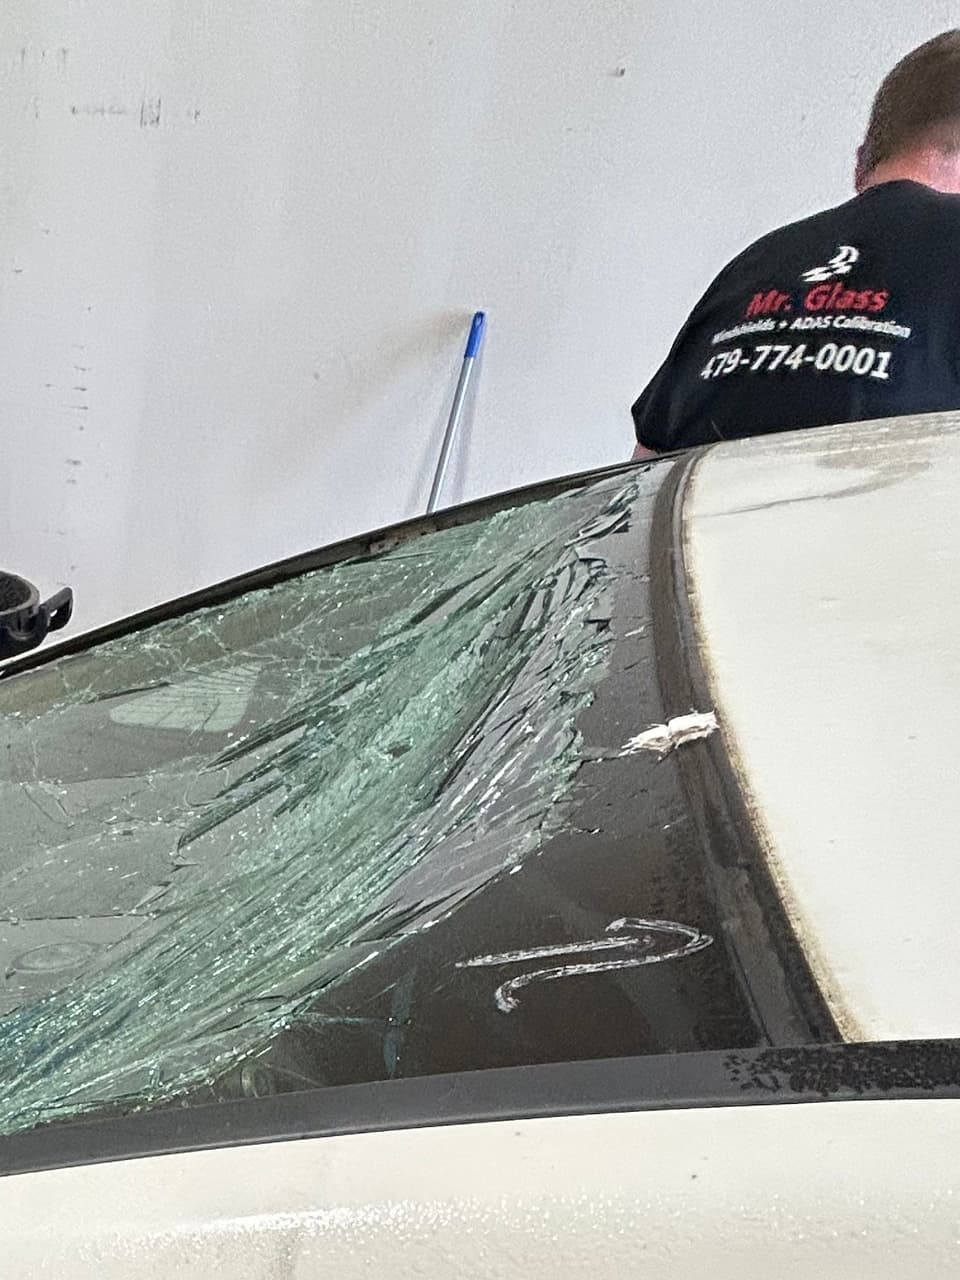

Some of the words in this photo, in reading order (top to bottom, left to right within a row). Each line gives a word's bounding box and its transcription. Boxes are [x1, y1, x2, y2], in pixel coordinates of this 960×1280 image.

[744, 288, 791, 318] Mr.
[803, 282, 889, 312] Glass
[789, 315, 833, 330] ADAS
[700, 342, 892, 380] 479-774-0001
